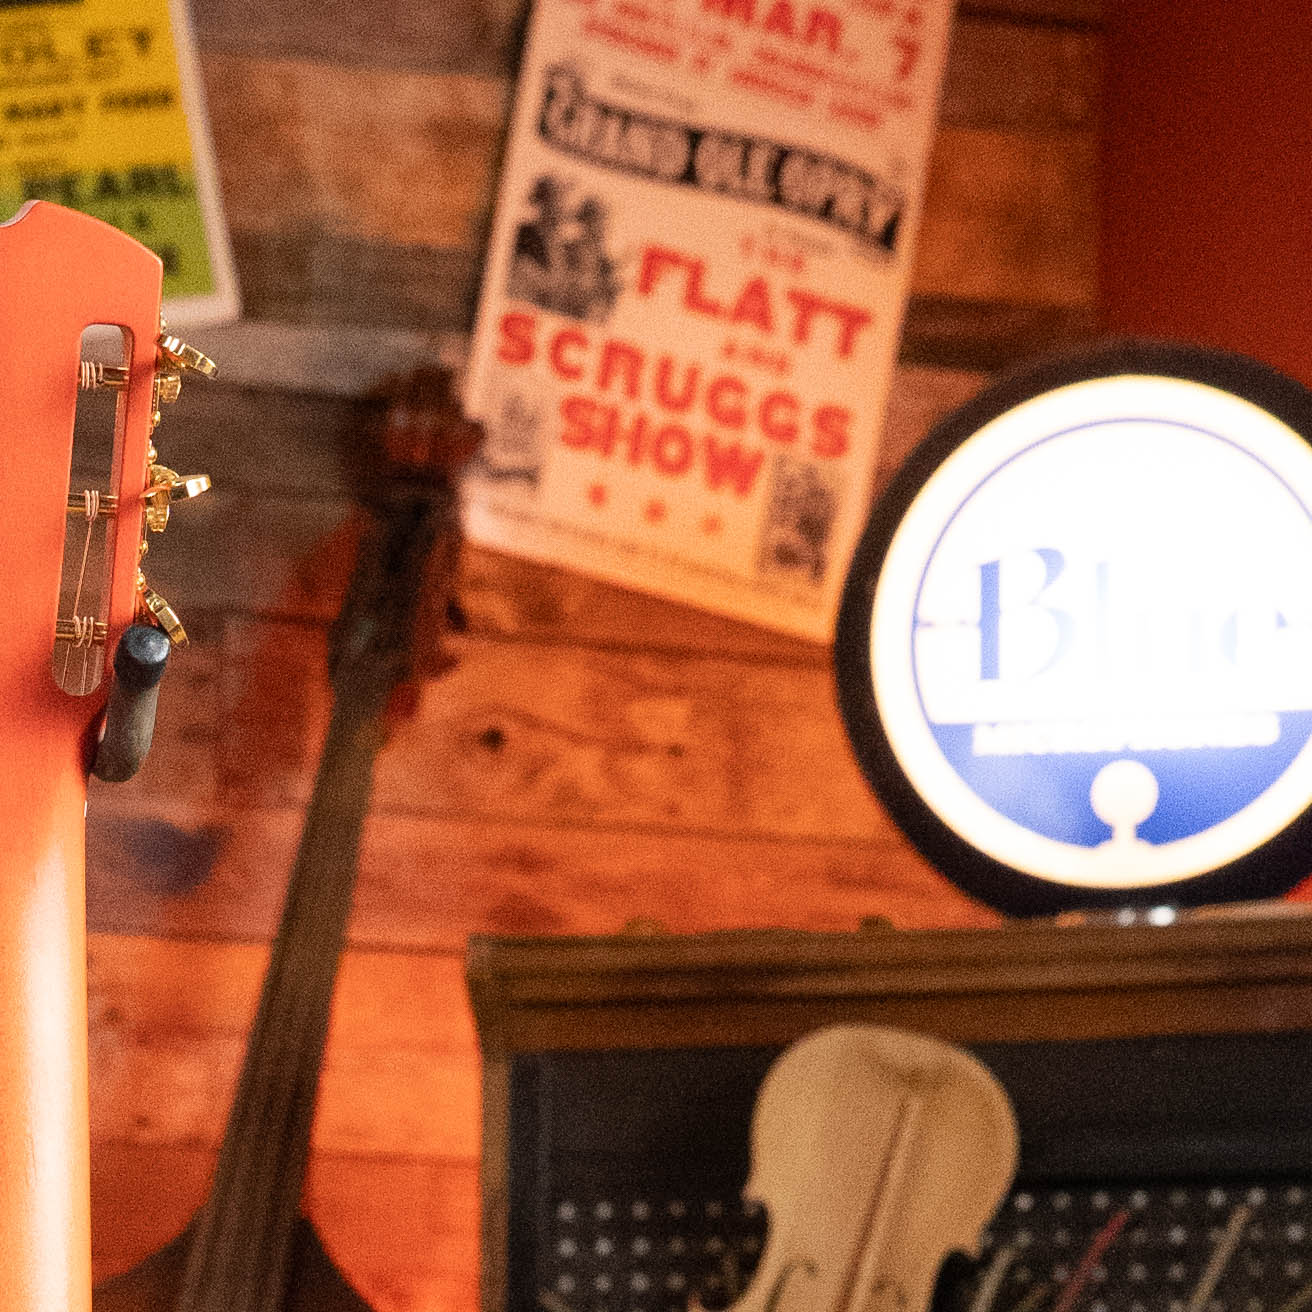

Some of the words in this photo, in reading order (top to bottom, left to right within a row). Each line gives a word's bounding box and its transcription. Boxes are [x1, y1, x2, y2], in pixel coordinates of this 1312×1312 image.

[637, 245, 875, 361] FLATT
[497, 312, 852, 460] SCRUGGS
[560, 396, 765, 499] SHOW
